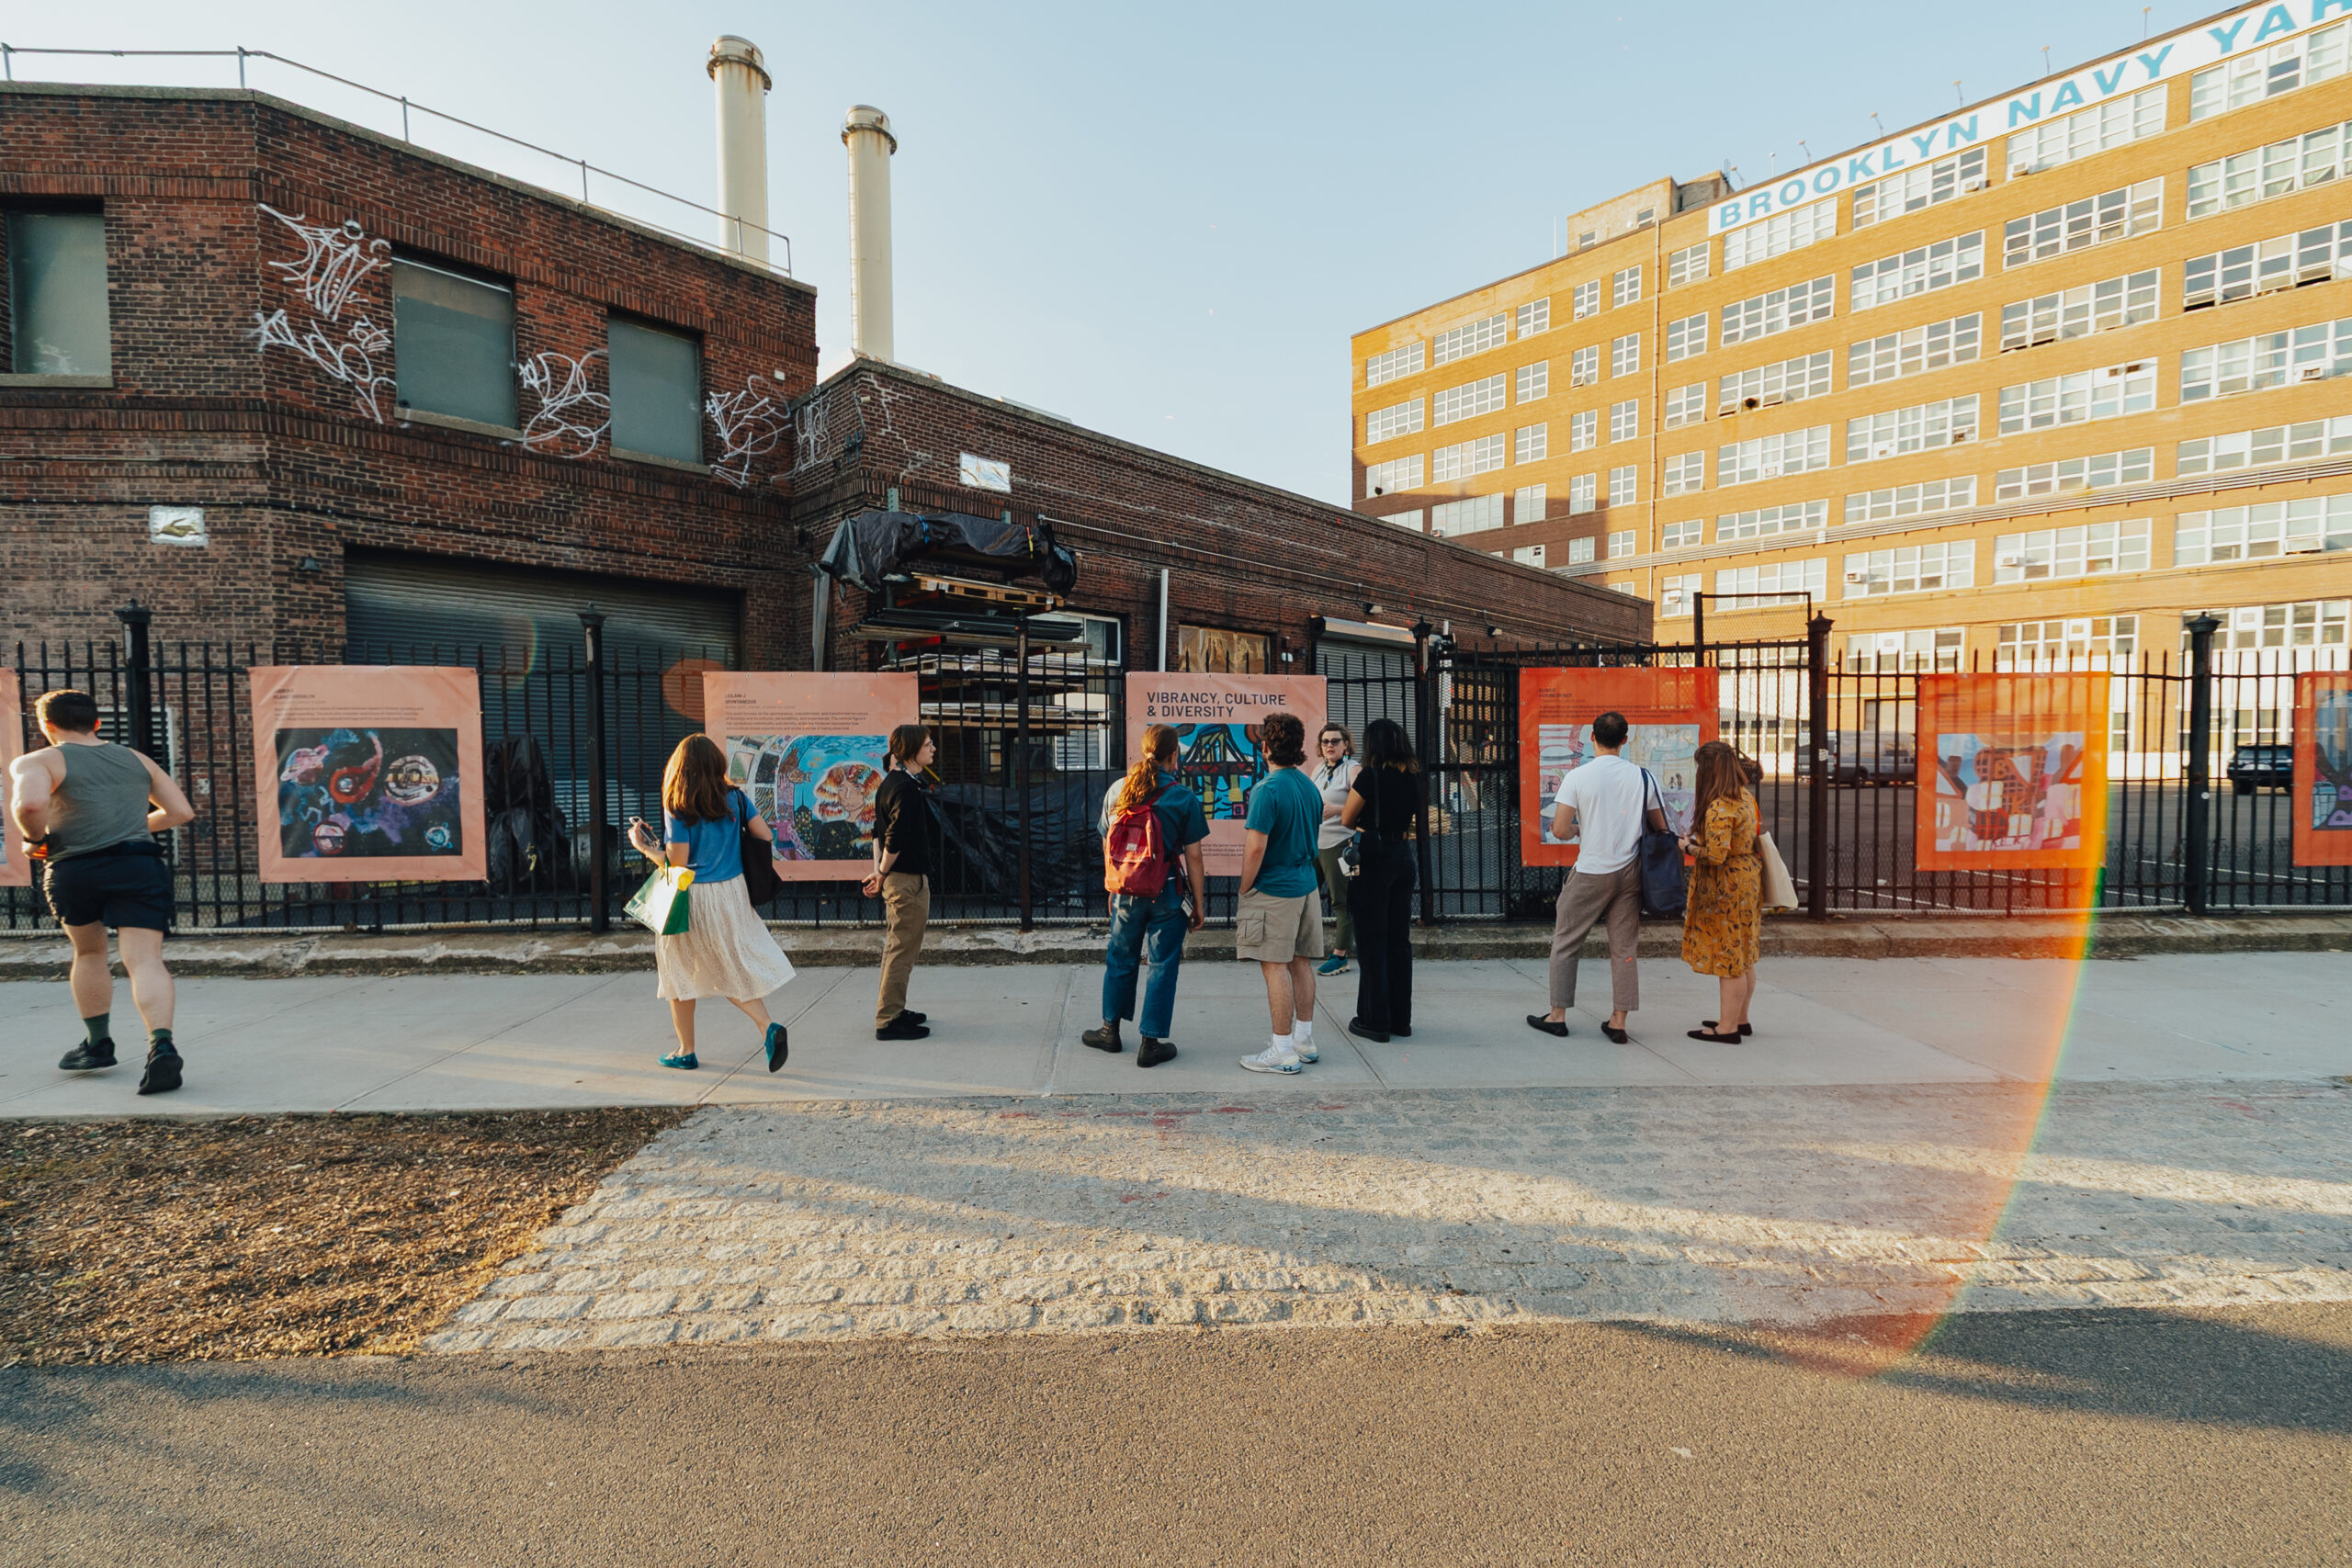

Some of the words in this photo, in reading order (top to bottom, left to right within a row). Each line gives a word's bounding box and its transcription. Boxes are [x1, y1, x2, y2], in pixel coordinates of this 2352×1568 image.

[1720, 114, 1978, 229] BROOKLYN
[2008, 42, 2176, 129] NAVY
[1147, 692, 1219, 705] VIBRANCY,
[1225, 693, 1287, 705] CULTURE
[1147, 705, 1157, 716] &
[1161, 705, 1235, 717] DIVERSITY
